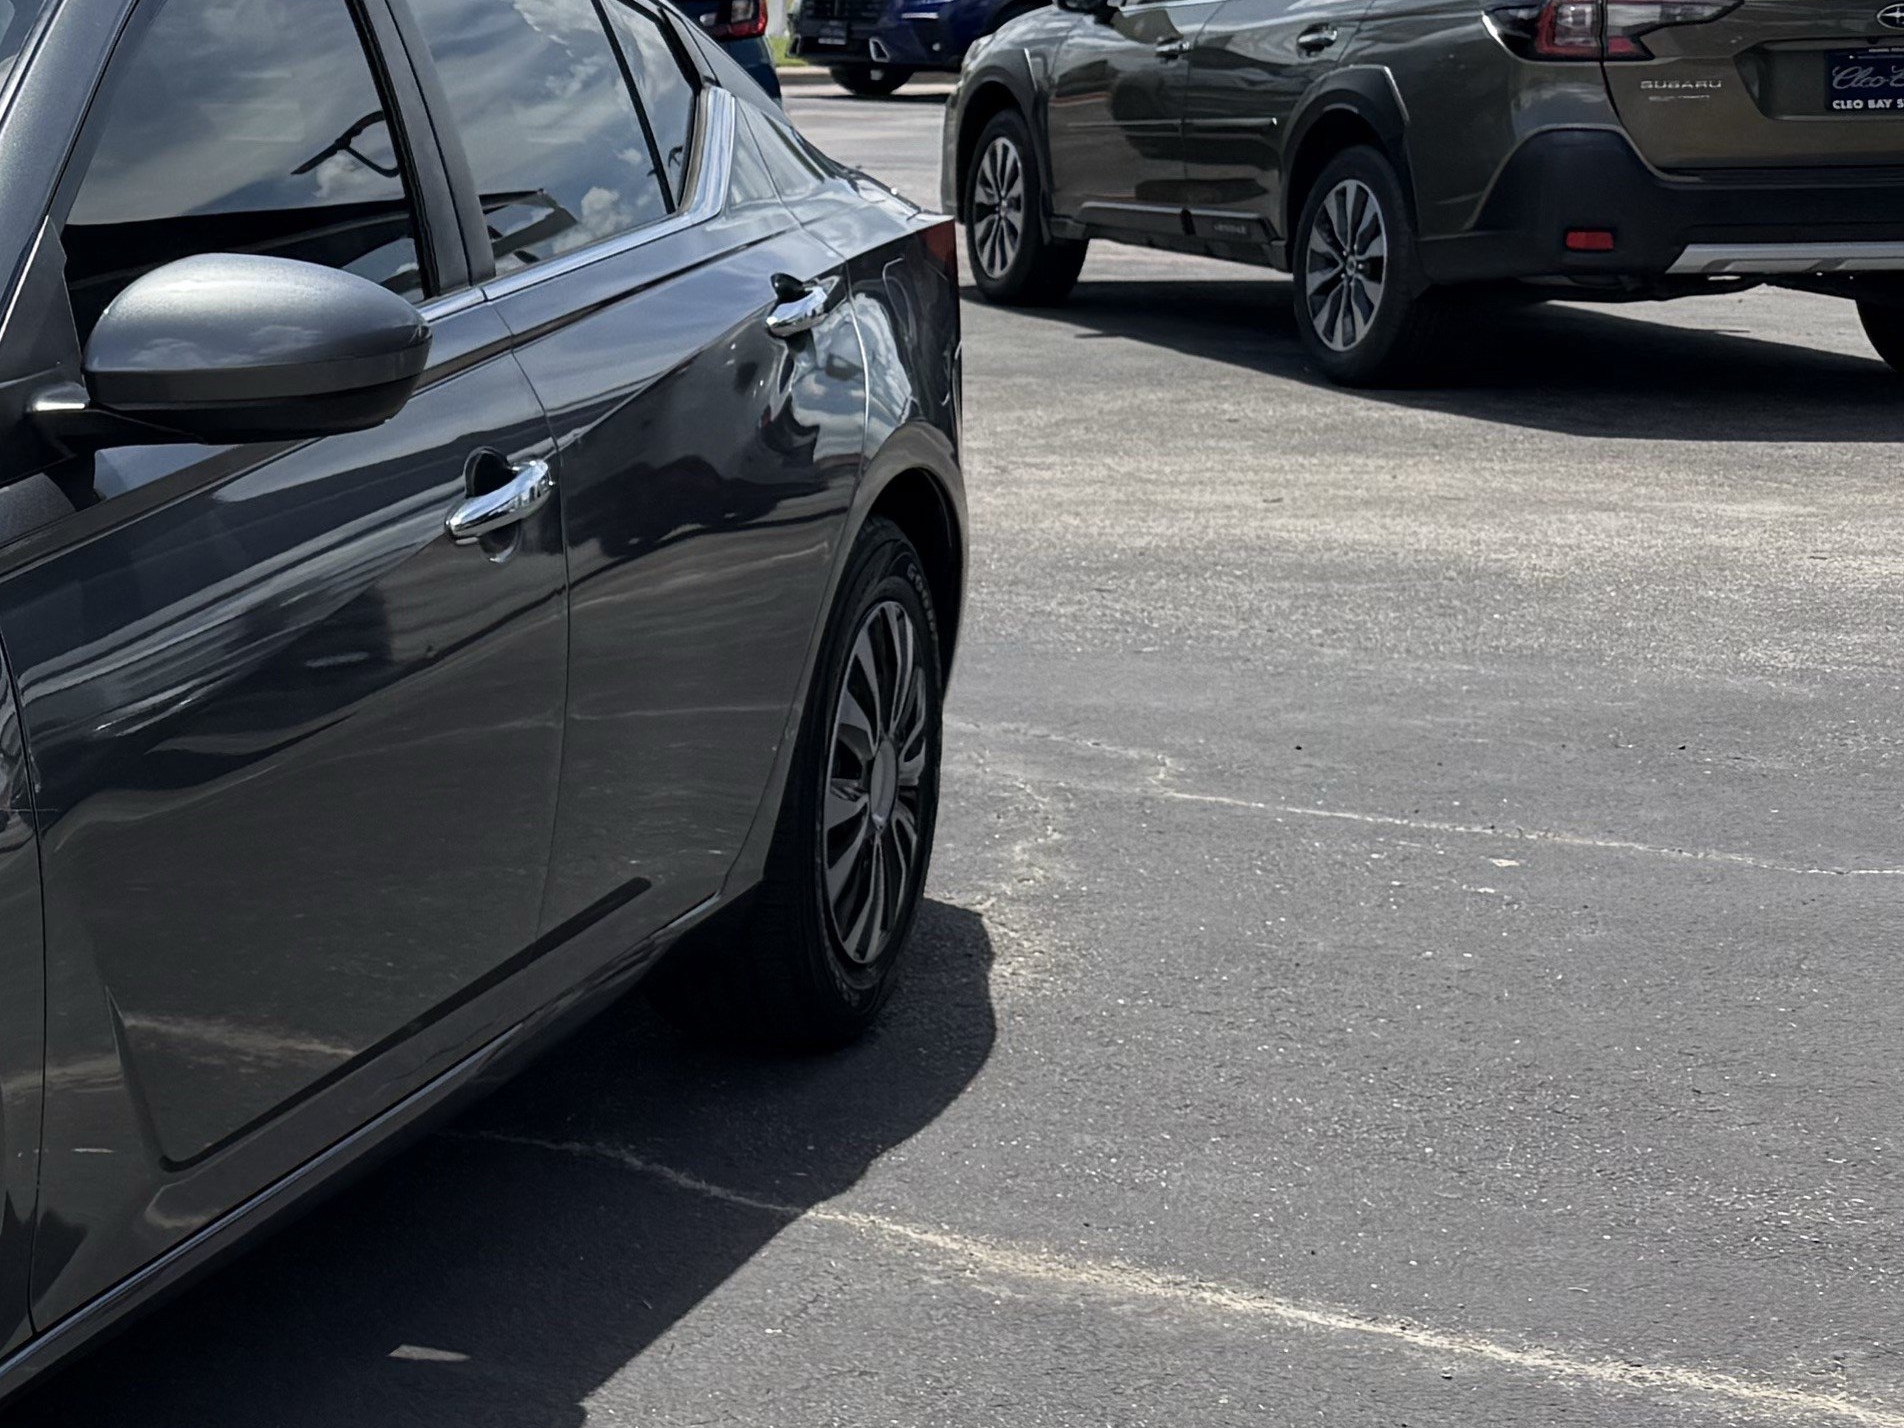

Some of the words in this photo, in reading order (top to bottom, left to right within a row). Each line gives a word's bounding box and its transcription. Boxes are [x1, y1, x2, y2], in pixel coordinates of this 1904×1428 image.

[1640, 80, 1722, 89] SUBARU
[1832, 99, 1864, 110] CLEO
[1868, 99, 1892, 109] BAY
